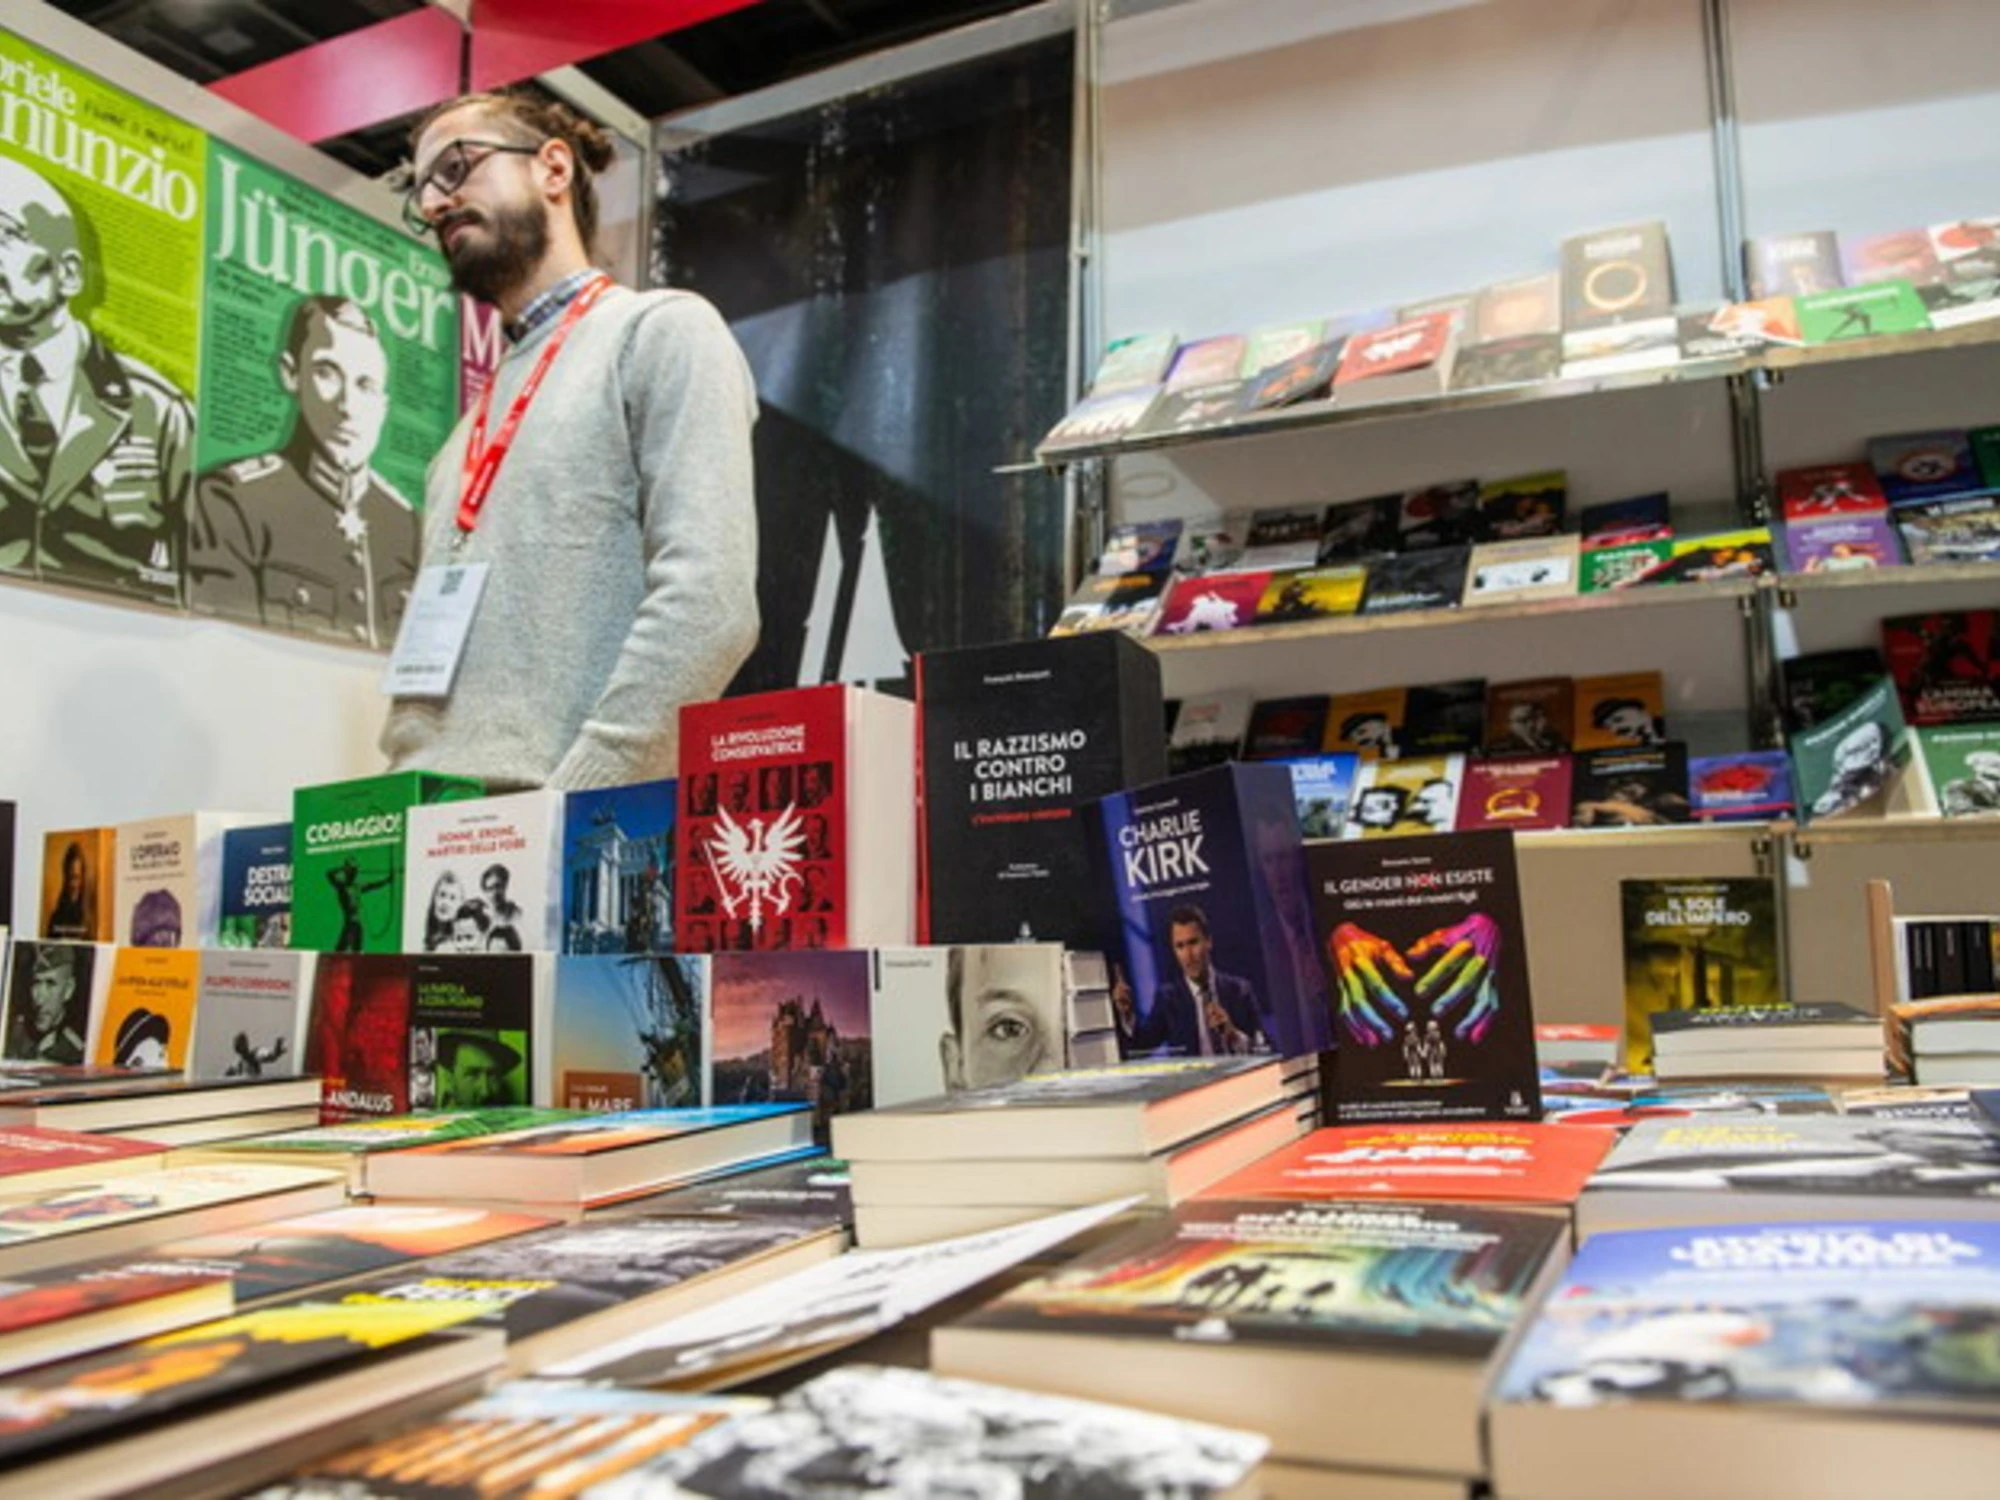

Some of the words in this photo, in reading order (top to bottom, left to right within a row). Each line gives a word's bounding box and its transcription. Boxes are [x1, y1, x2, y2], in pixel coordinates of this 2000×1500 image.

[213, 153, 456, 351] Jünger
[954, 740, 972, 761] IL
[977, 729, 1087, 758] RAZZISMO
[974, 754, 1066, 779] CONTRO
[970, 783, 977, 802] I
[983, 775, 1073, 801] BIANCHI
[1118, 809, 1202, 848] CHARLIE
[1124, 834, 1211, 888] KIRK
[1323, 880, 1339, 895] IL
[1339, 874, 1402, 894] GENDER
[1445, 867, 1495, 886] ESISTE
